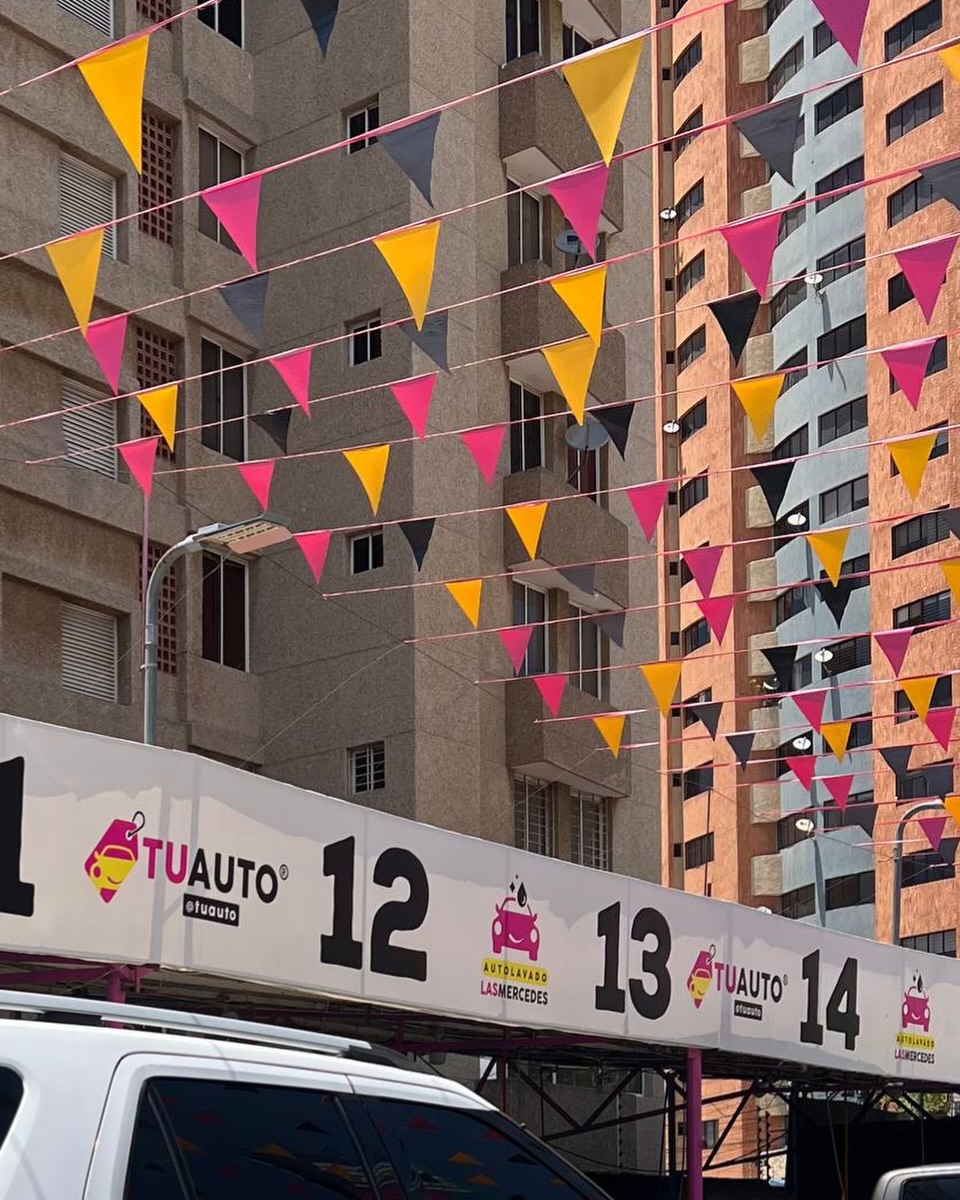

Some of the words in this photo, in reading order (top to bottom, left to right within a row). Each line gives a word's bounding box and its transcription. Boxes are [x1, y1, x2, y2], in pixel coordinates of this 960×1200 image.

[185, 899, 237, 922] @tuauto
[320, 836, 429, 982] 12
[483, 962, 548, 984] AUTOLAVADO
[595, 901, 672, 1020] 13
[480, 981, 549, 1006] LASMERCEDES
[800, 949, 860, 1051] 14
